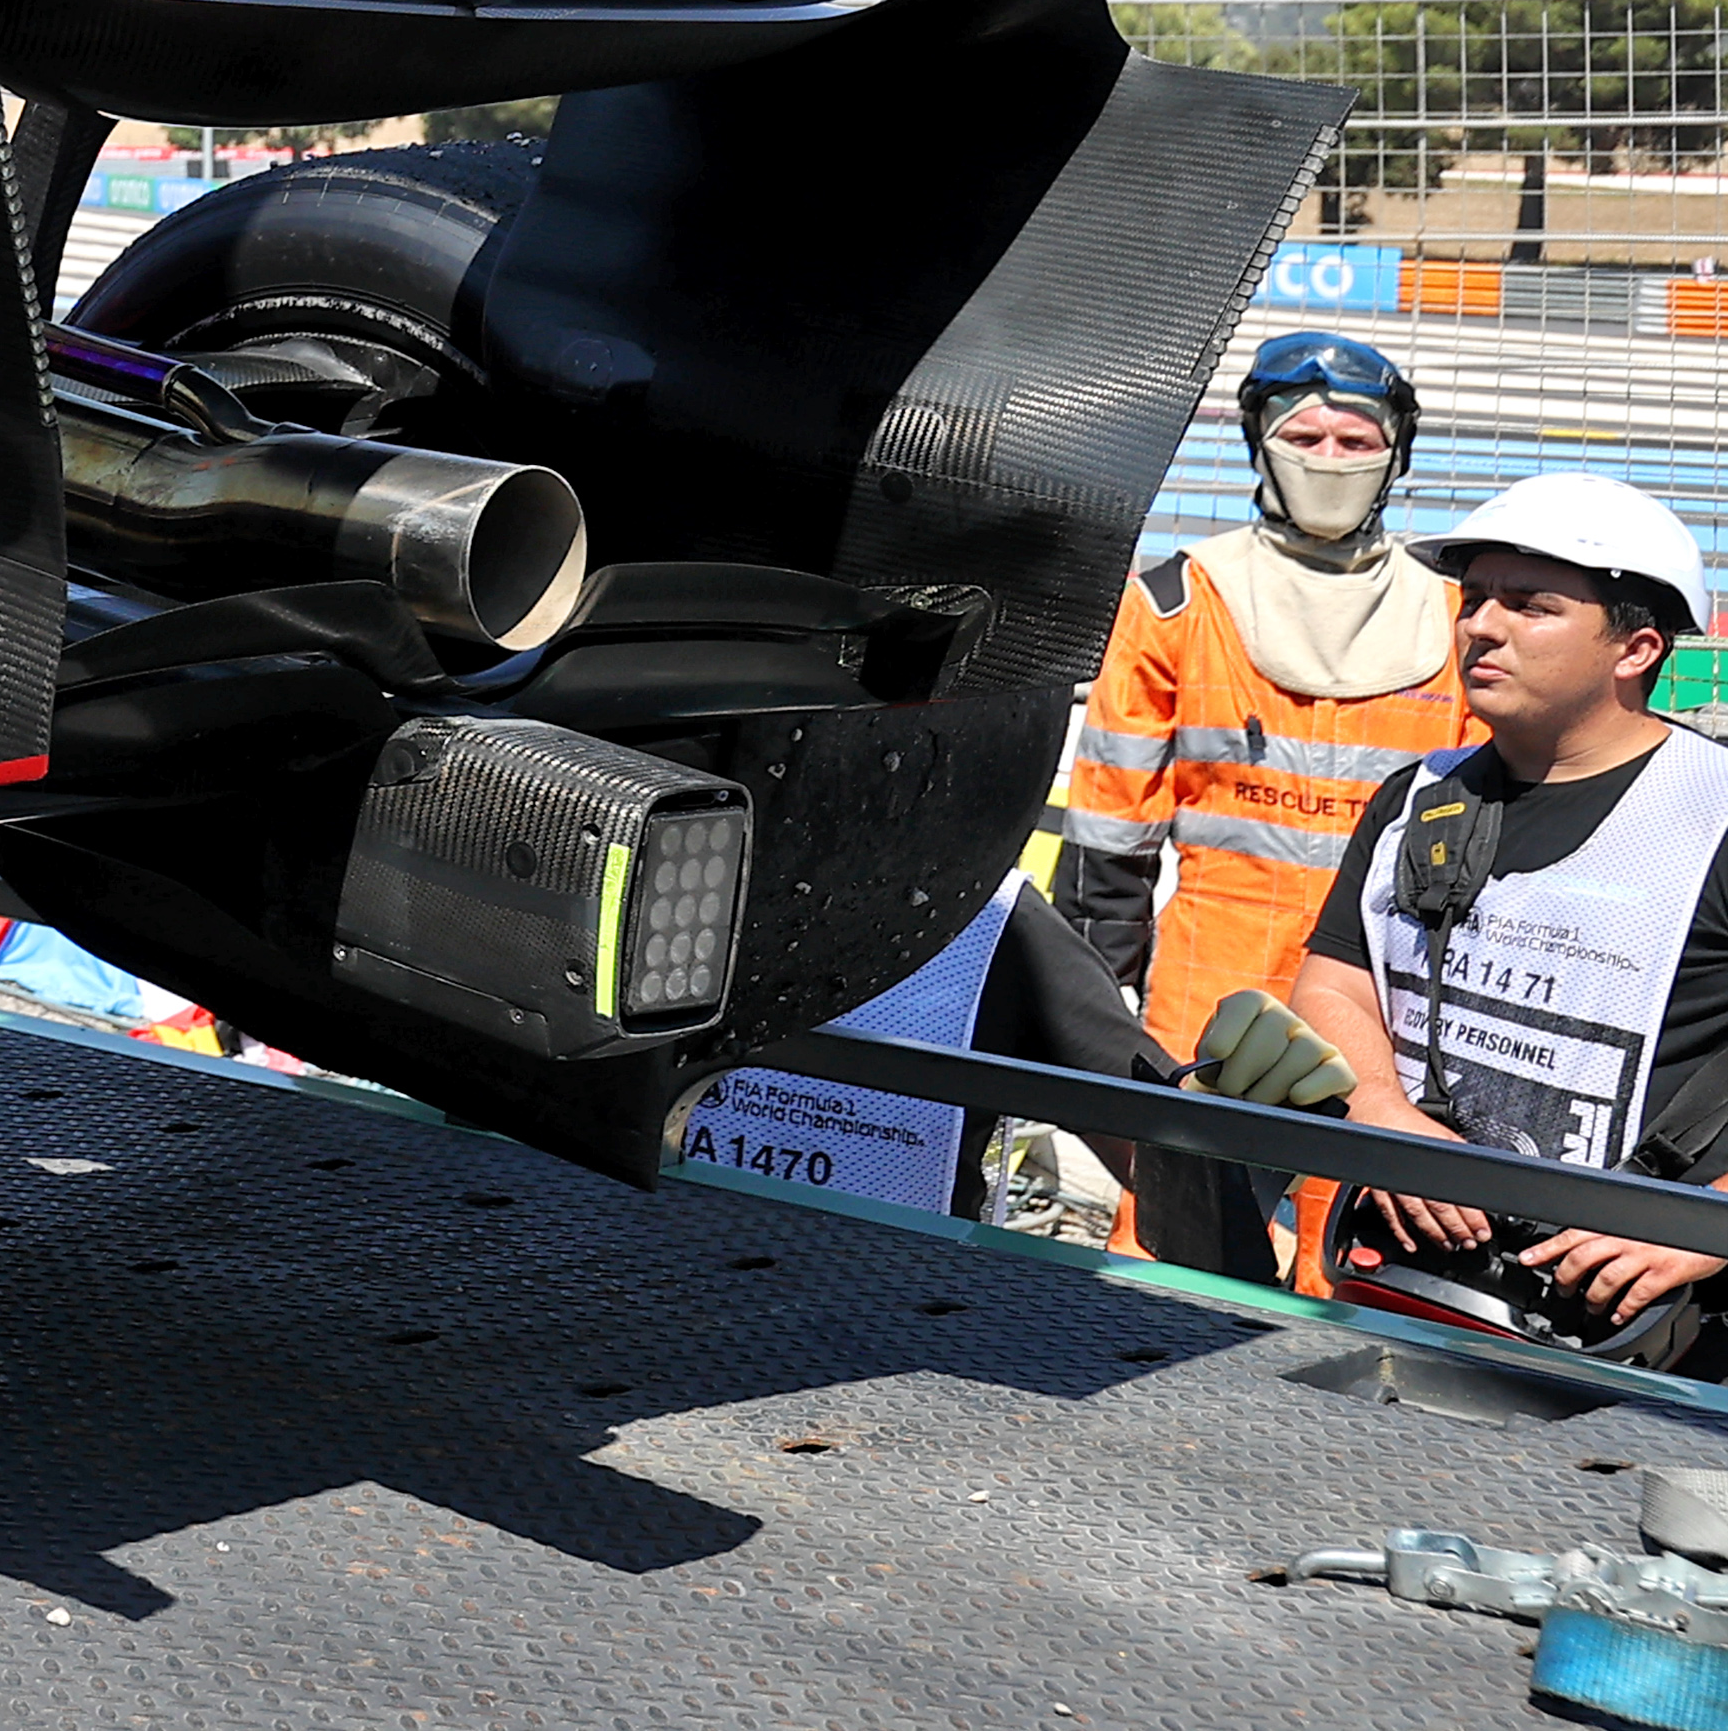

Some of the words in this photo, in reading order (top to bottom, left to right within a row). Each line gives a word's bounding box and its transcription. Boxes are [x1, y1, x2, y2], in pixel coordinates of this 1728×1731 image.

[1233, 781, 1337, 817] RESCUE
[1344, 798, 1368, 819] T
[1455, 1023, 1556, 1071] PERSONNEL
[732, 1079, 763, 1099] FIA
[765, 1085, 843, 1115] Formula
[731, 1096, 786, 1121] World
[787, 1108, 918, 1147] Championship
[729, 1134, 833, 1187] 1470
